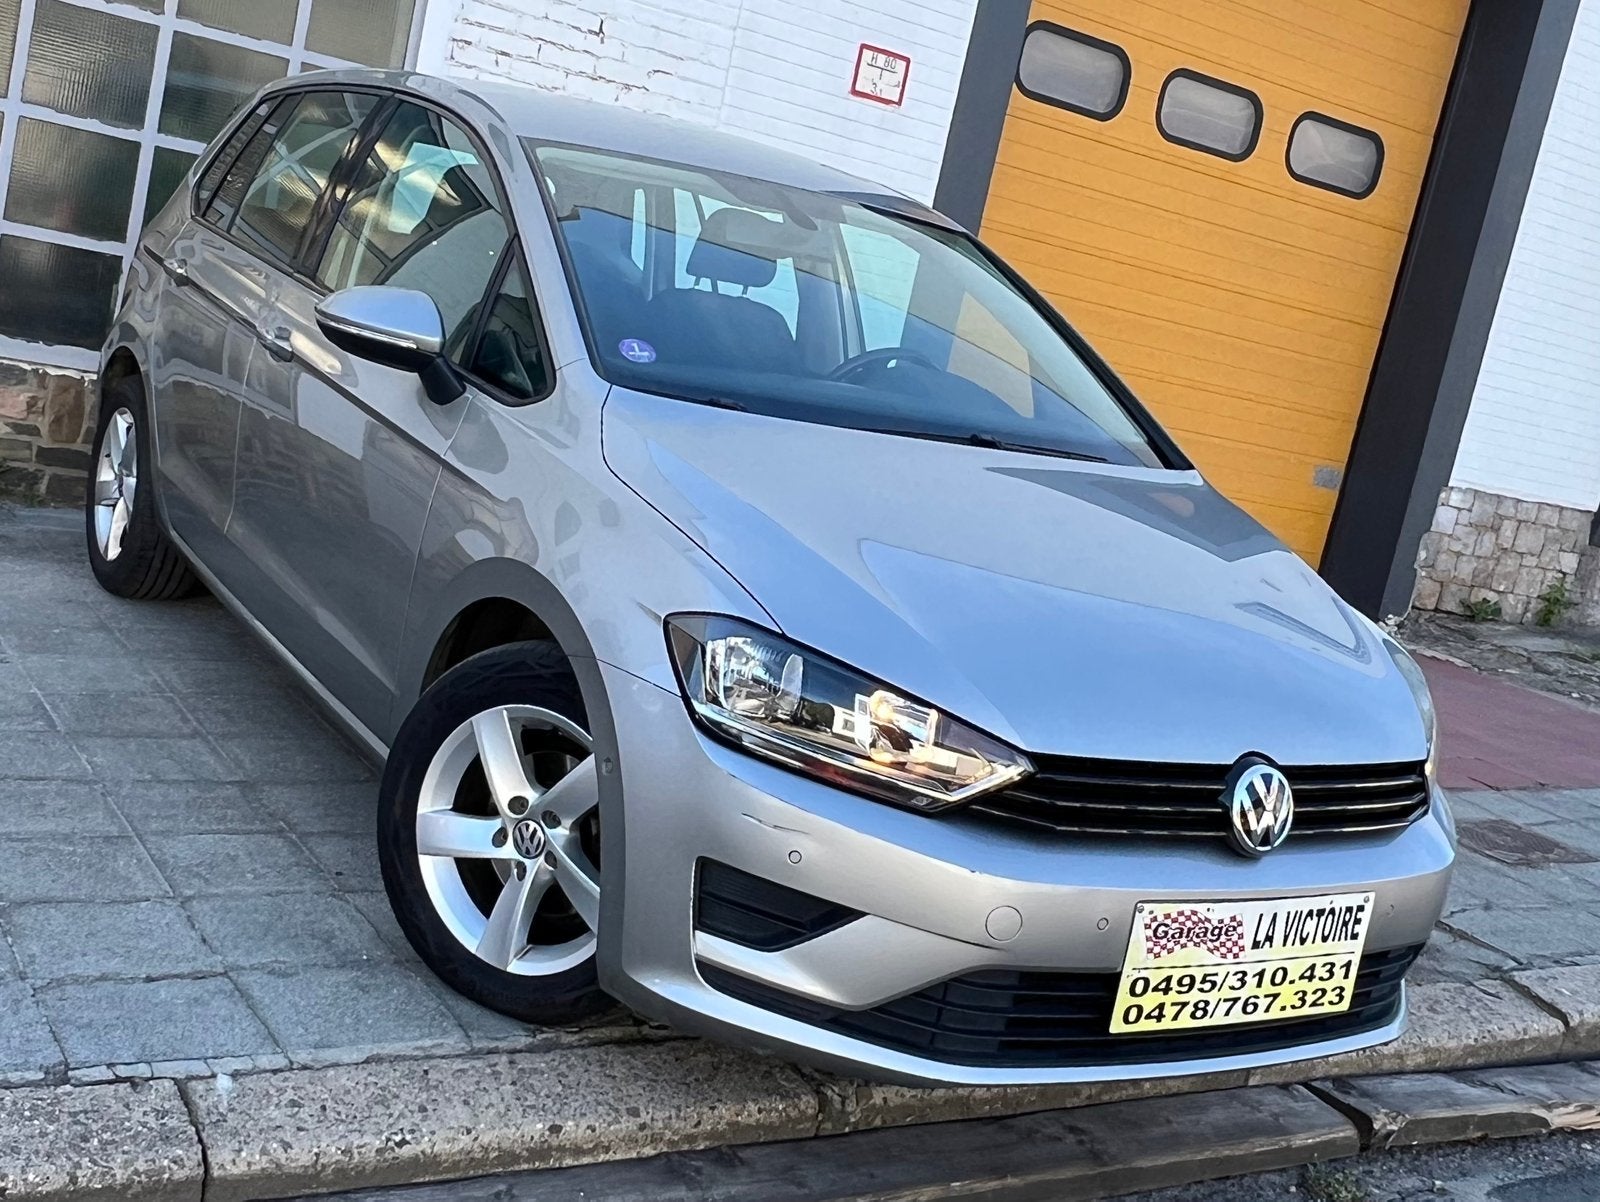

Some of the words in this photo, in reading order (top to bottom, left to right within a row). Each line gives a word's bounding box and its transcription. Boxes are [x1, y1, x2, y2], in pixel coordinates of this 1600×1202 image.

[871, 52, 879, 65] H
[883, 56, 898, 70] 80
[1152, 922, 1238, 943] Garage
[1251, 911, 1278, 950] LA
[1282, 904, 1365, 947] VICTOIRE
[1129, 960, 1353, 998] 0495/310.431
[1122, 985, 1346, 1025] 0478/767.323
